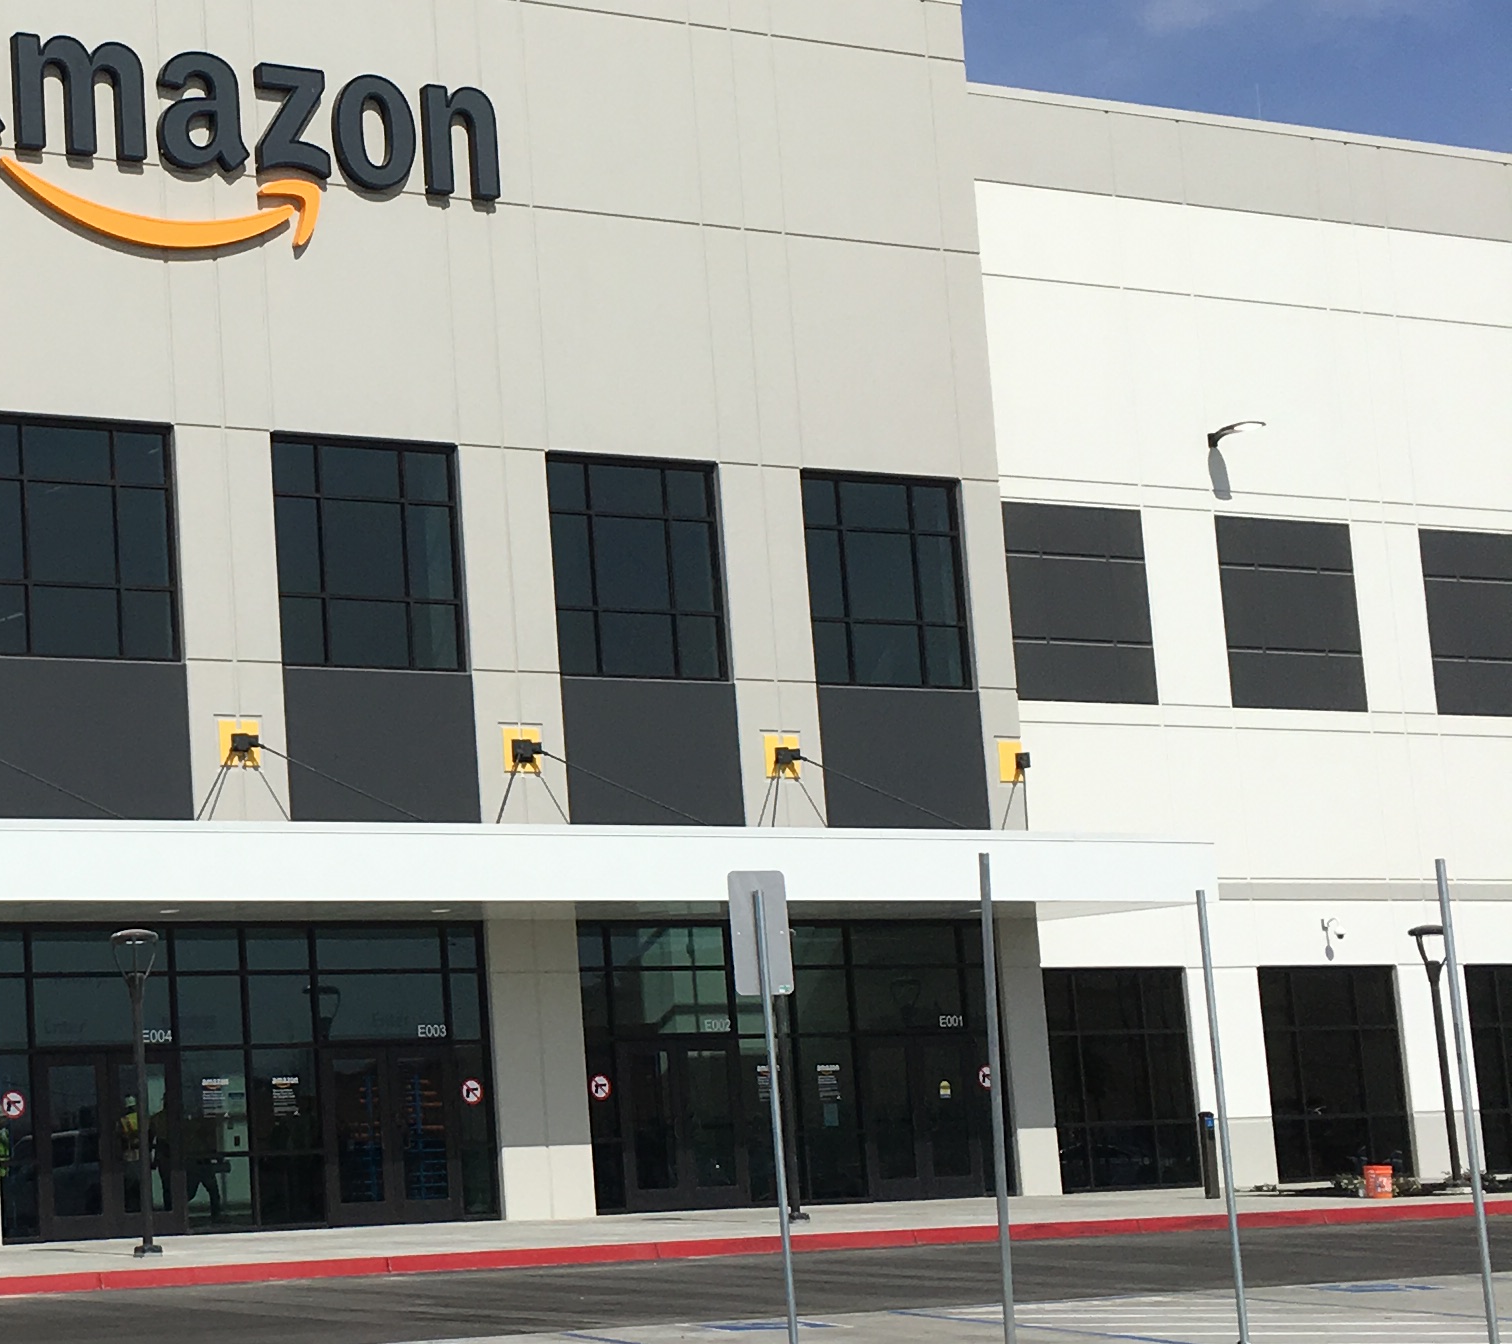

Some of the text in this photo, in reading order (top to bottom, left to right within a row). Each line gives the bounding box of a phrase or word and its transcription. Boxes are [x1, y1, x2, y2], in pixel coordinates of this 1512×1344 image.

[704, 1019, 731, 1032] E002
[939, 1015, 964, 1028] E001
[141, 1029, 173, 1044] E004
[417, 1023, 447, 1038] E003
